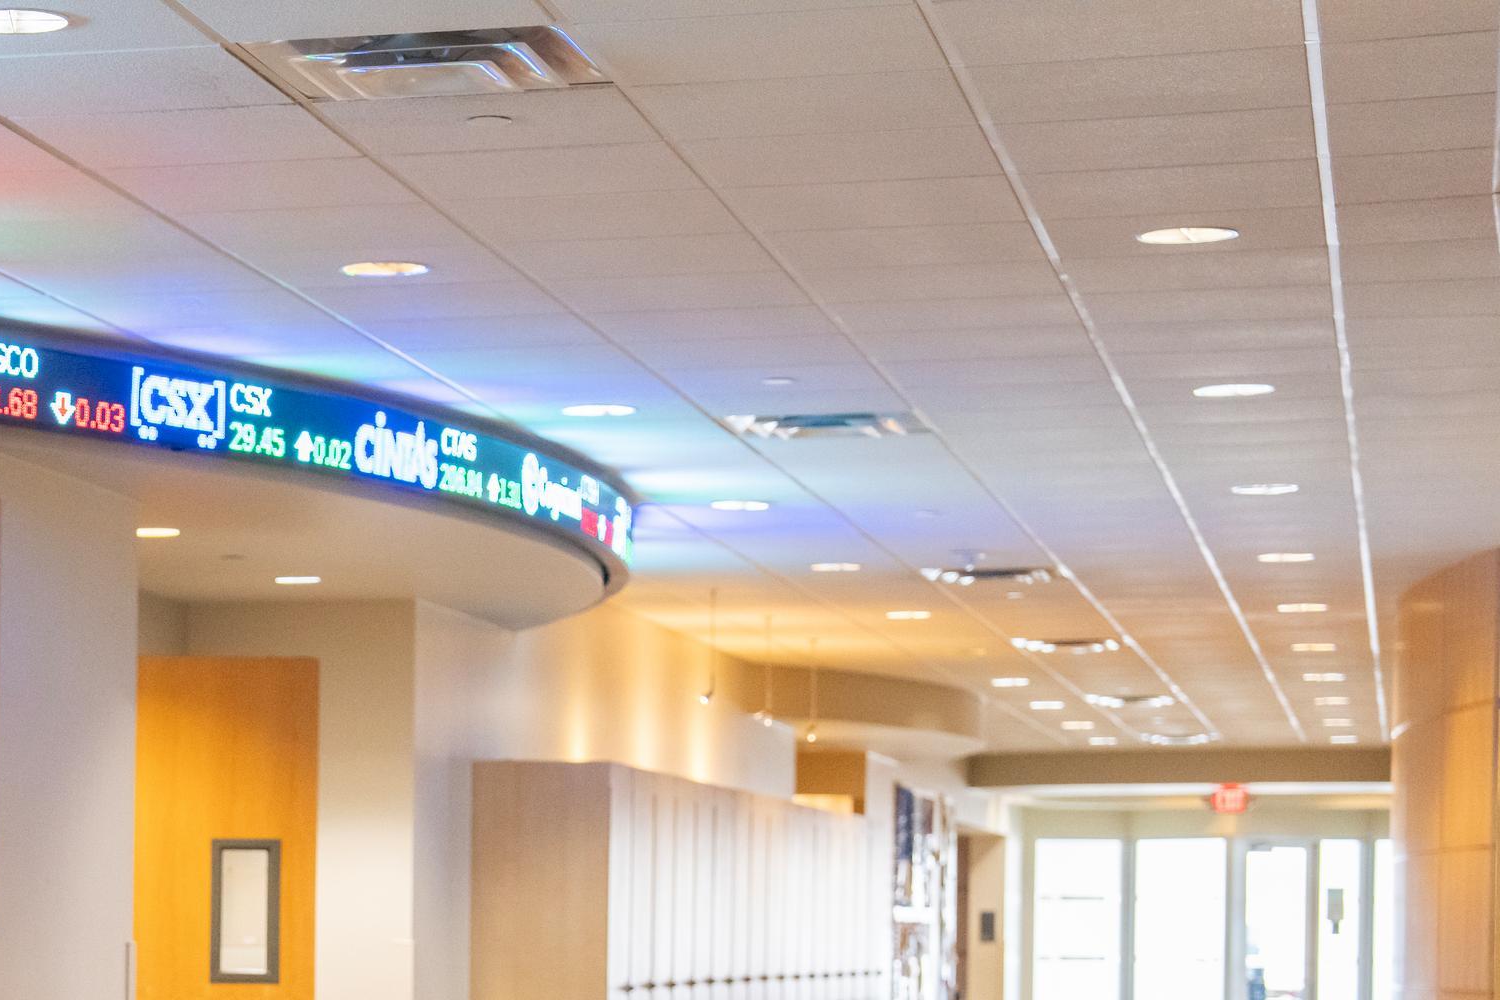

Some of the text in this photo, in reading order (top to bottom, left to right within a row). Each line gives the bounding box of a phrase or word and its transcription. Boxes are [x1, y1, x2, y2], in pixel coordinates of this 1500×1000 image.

[74, 397, 125, 433] 0.03
[229, 383, 272, 417] CSX
[229, 422, 352, 469] 29.45 0.02
